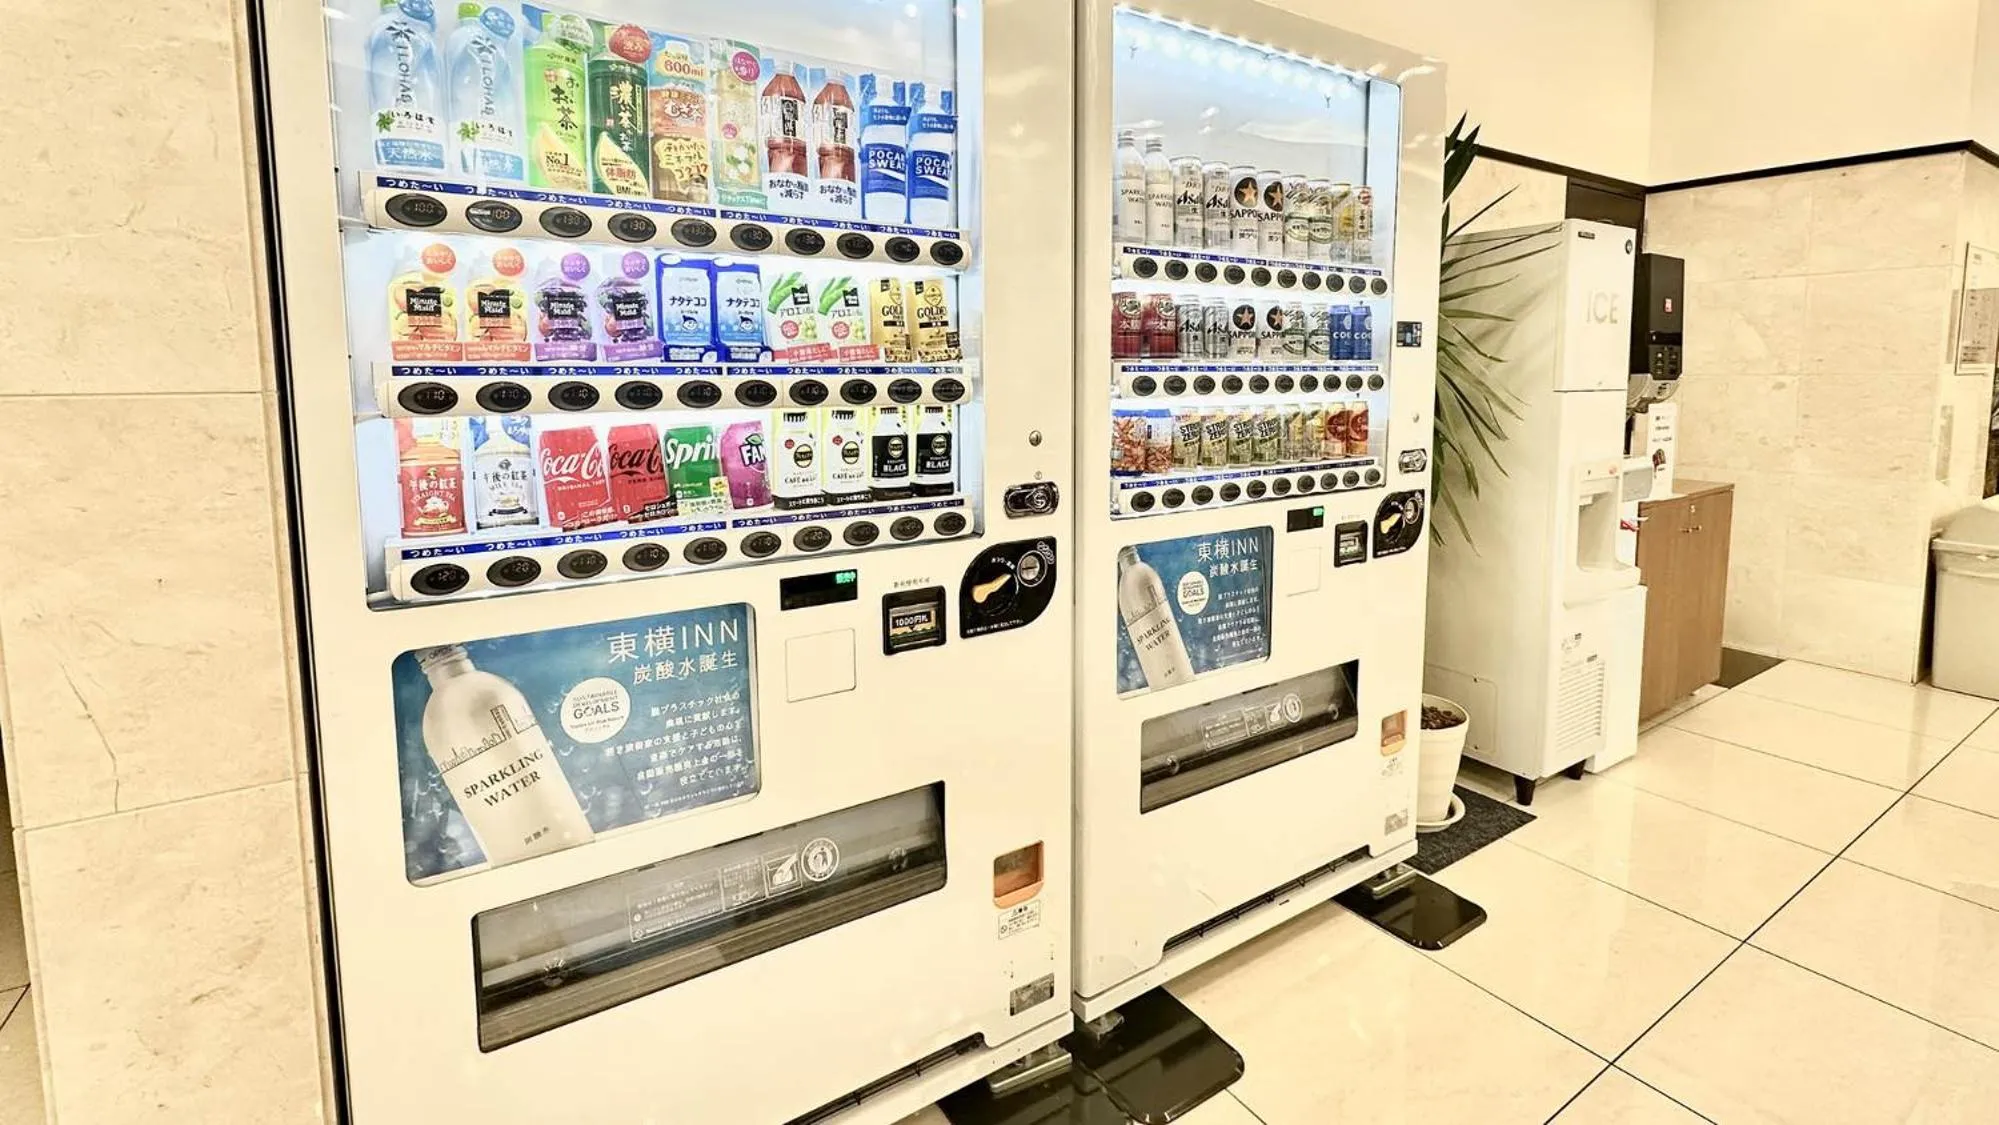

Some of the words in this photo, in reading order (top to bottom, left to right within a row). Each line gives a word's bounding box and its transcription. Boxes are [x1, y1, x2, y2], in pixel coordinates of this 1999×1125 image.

[1586, 291, 1619, 324] ICE
[883, 464, 907, 472] BLACK
[926, 461, 950, 469] BLACK
[1197, 536, 1259, 562] 東横INN
[607, 618, 738, 664] 東横INN
[633, 649, 738, 685] 炭酸水誕生
[573, 701, 620, 719] GOALS
[463, 750, 544, 799] SPARKLING
[483, 769, 542, 807] WATER
